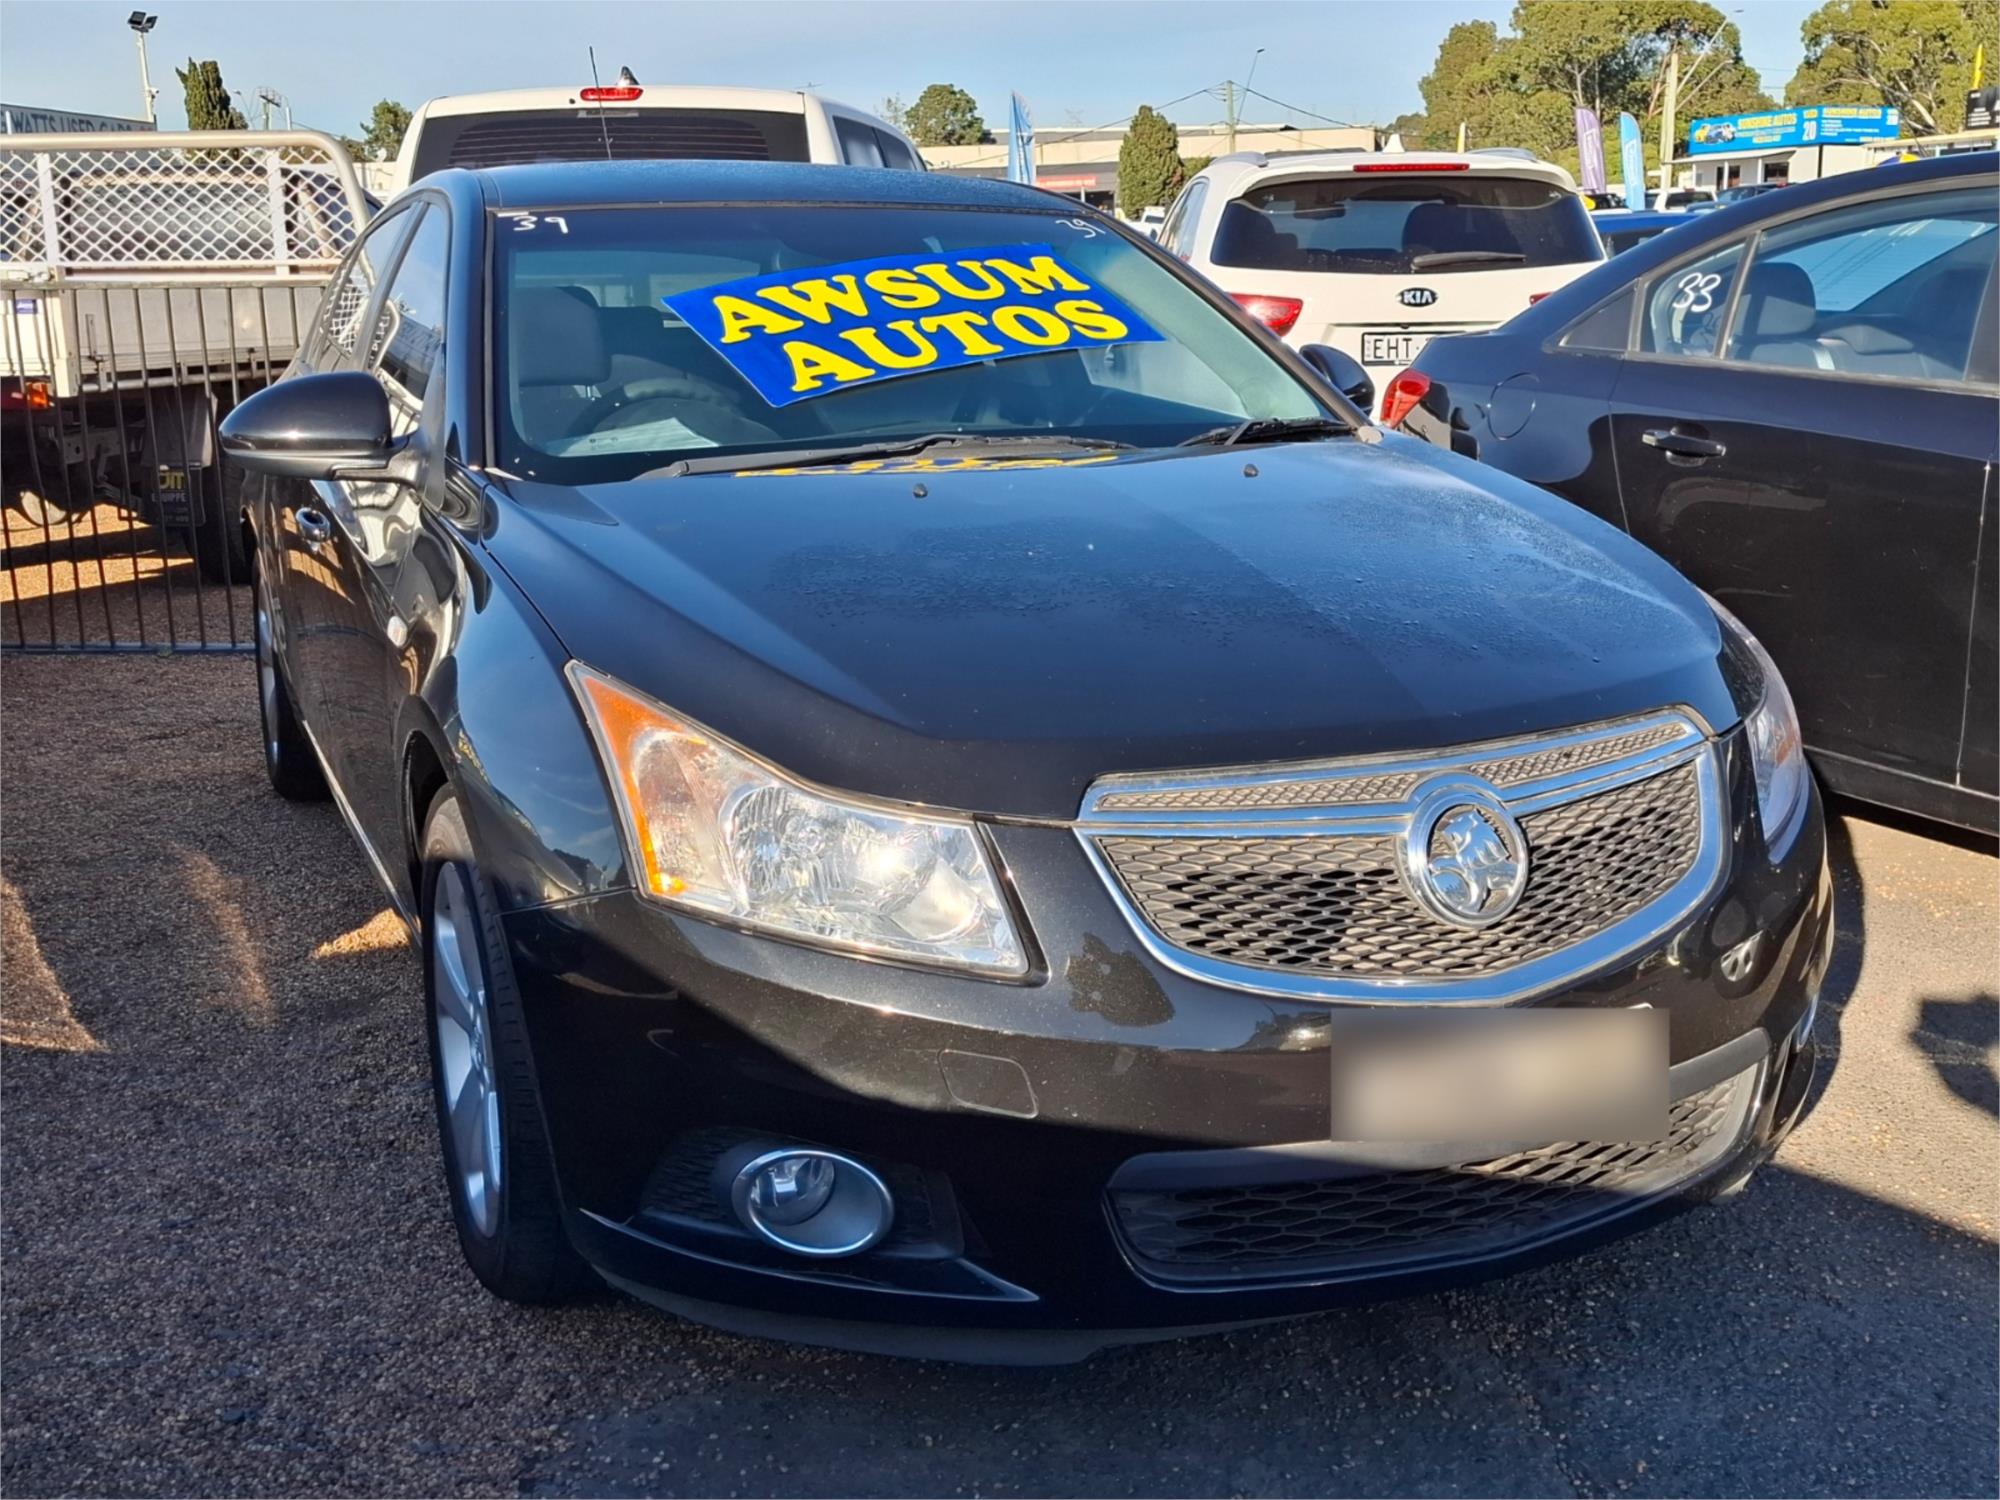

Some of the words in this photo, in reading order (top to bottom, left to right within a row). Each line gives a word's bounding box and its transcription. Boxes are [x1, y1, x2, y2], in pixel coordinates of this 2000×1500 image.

[10, 110, 57, 133] WATTS
[513, 215, 568, 234] 39
[712, 255, 1091, 344] AWSUM
[1403, 290, 1433, 304] KIA
[1672, 272, 1722, 313] 33
[782, 299, 1129, 393] AUTOS
